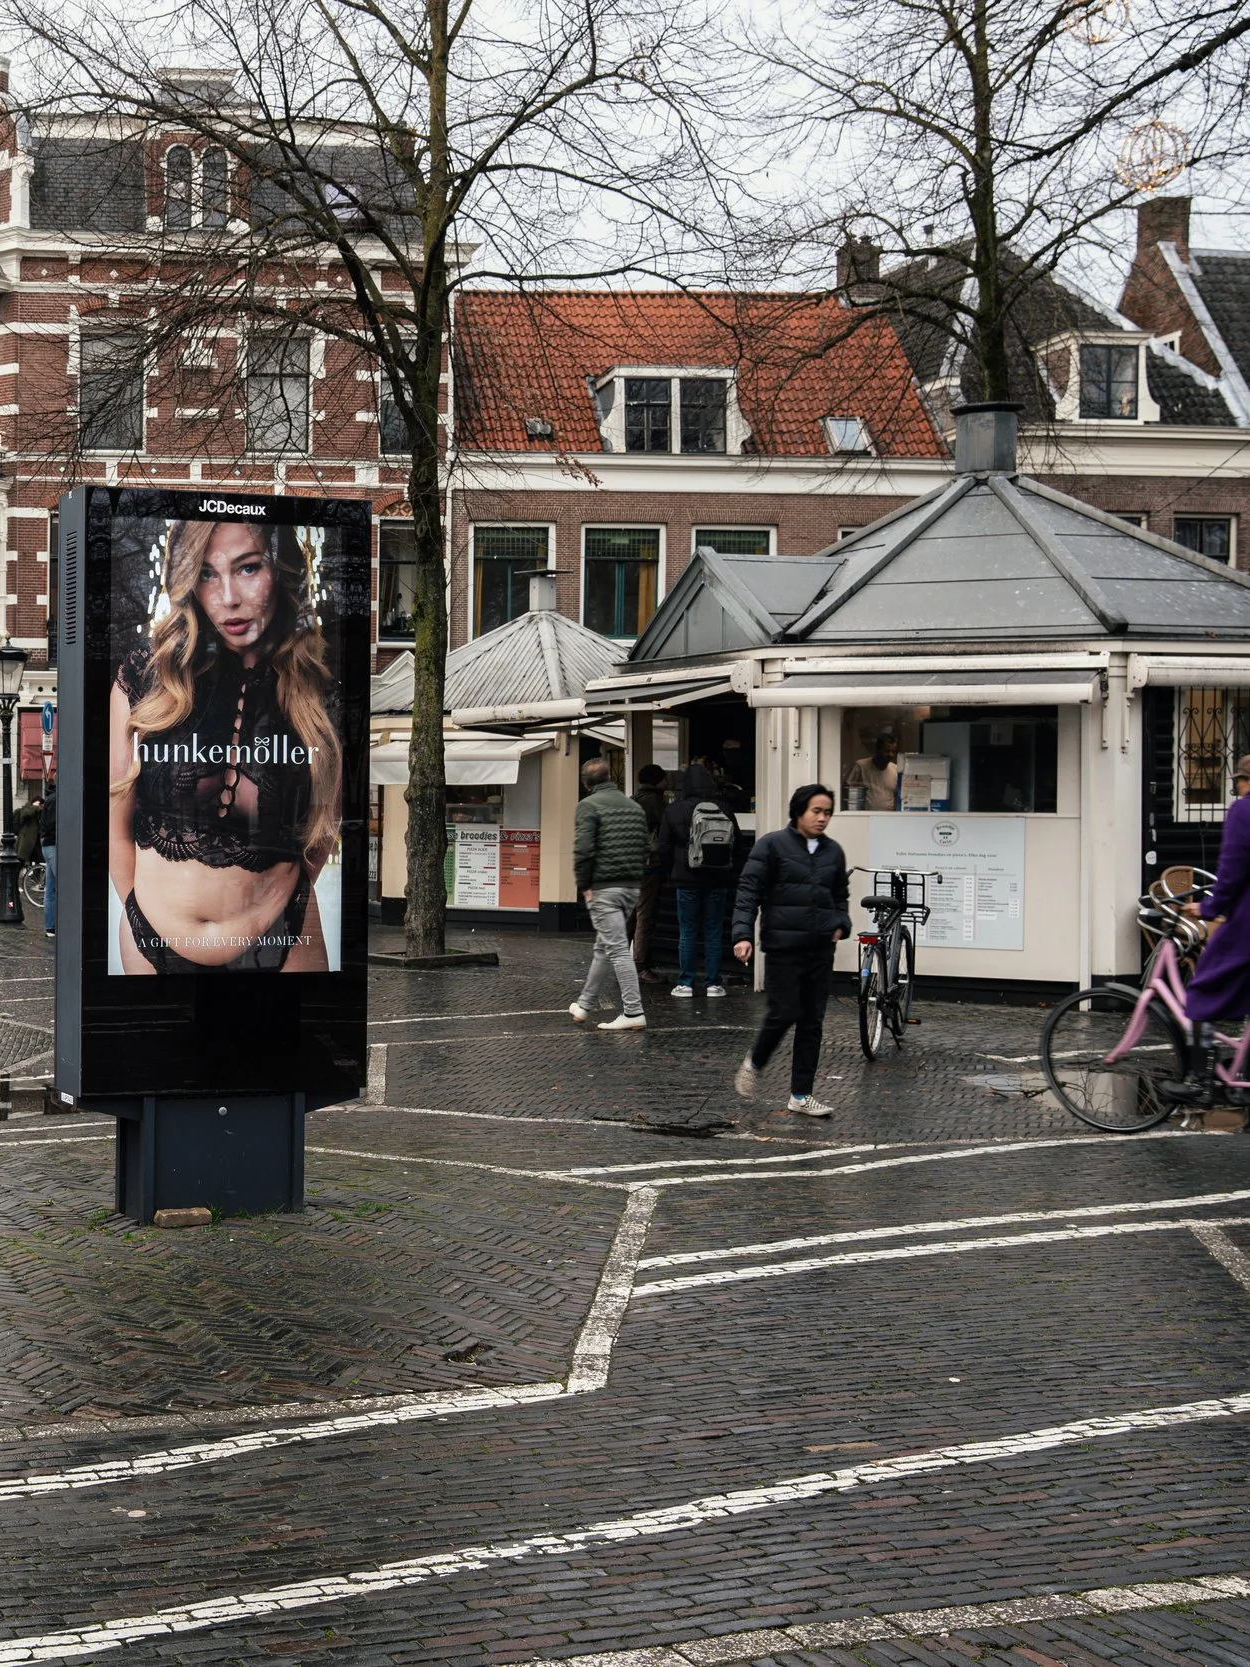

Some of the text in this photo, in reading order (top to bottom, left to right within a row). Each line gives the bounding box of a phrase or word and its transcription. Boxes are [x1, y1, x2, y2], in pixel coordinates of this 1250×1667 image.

[198, 500, 267, 516] JCDecaux
[137, 935, 312, 948] A GIFT FOR EVERY MOMENT
